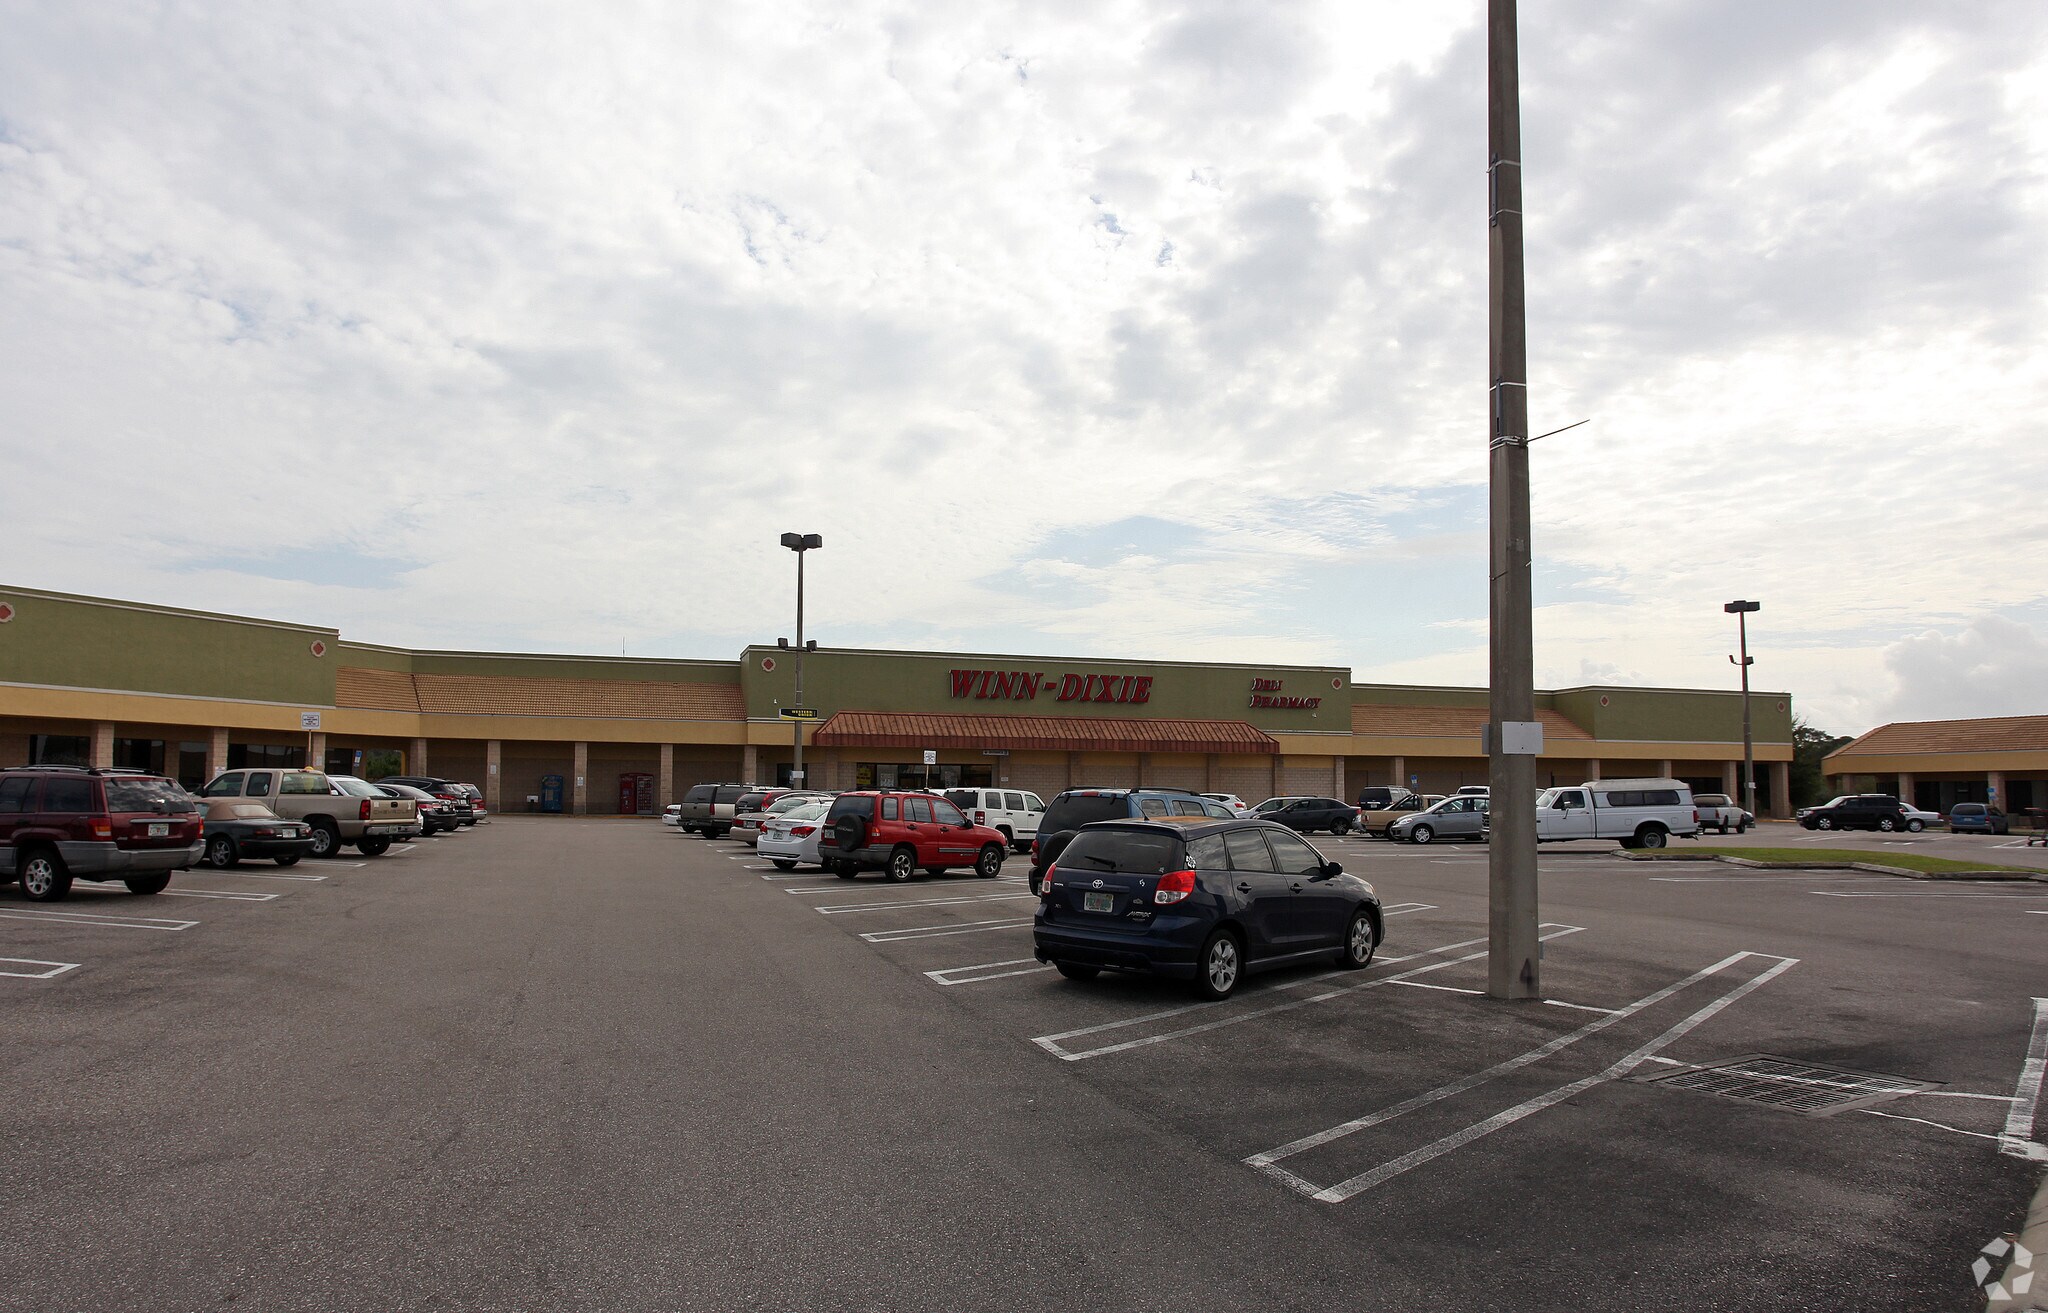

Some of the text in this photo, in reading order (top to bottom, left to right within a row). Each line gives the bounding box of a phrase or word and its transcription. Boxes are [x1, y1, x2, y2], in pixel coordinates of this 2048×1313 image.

[949, 669, 1154, 703] WINN-DIXIE
[1251, 677, 1283, 691] DELI
[1249, 694, 1322, 709] PHARMACY
